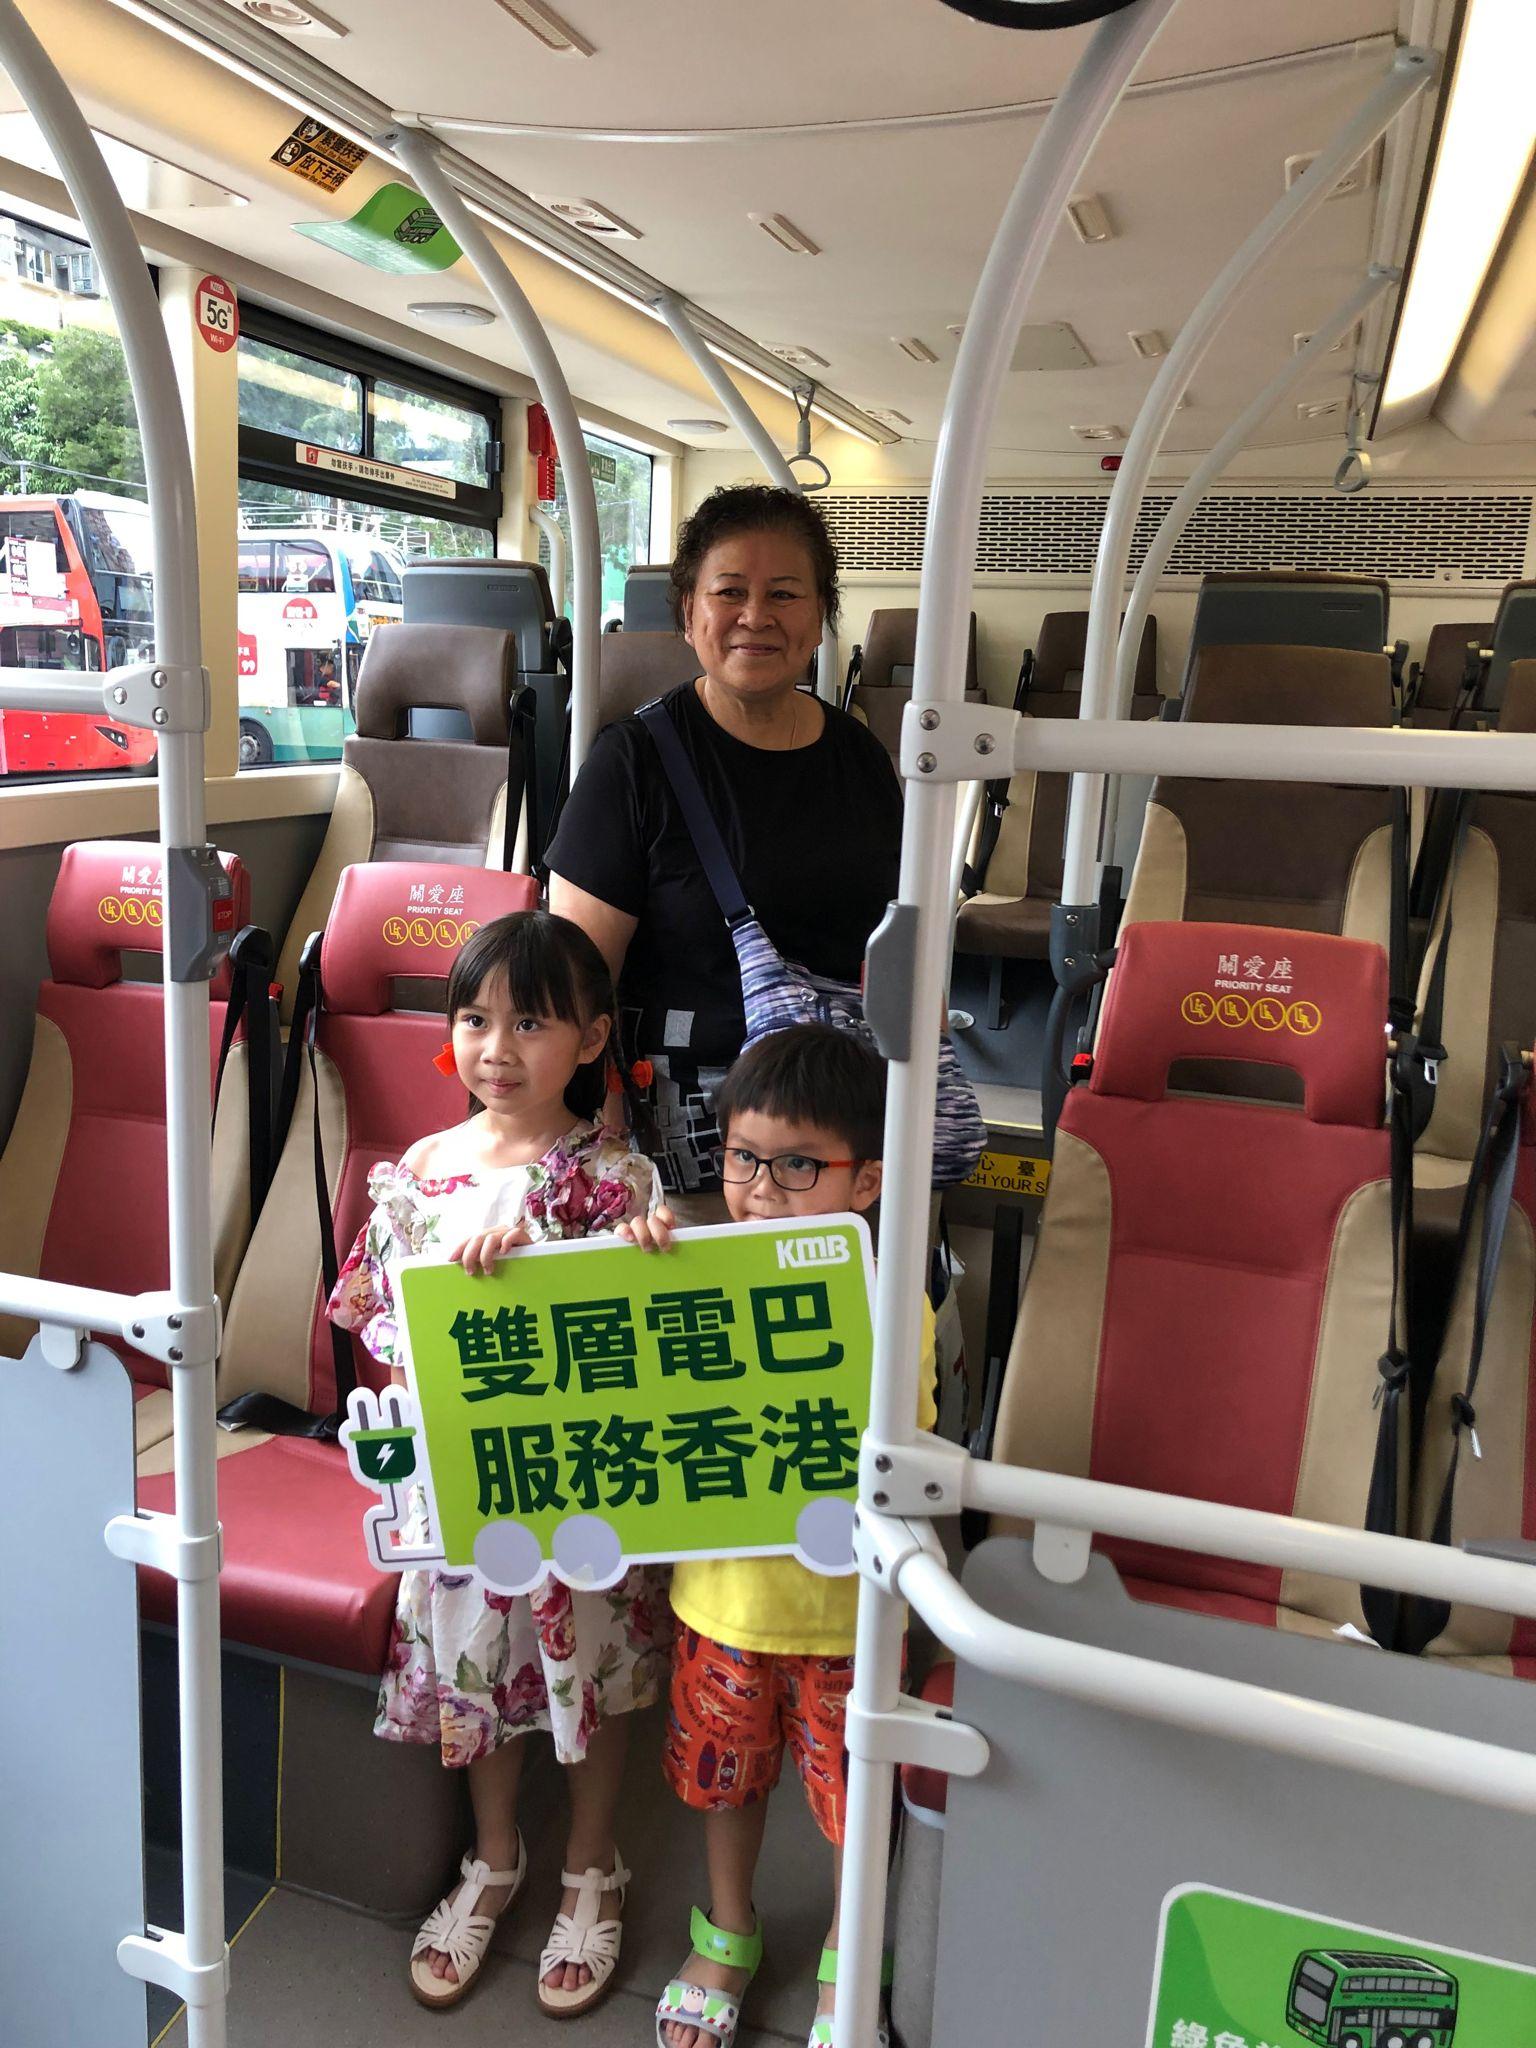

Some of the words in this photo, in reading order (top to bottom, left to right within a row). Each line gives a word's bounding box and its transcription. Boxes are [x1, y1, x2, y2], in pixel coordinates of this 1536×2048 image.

[299, 154, 348, 187] 放下手柄
[207, 298, 228, 330] 5G
[120, 886, 150, 896] PRIORITY
[409, 883, 465, 905] 關愛座
[407, 905, 442, 915] PRIORITY
[443, 907, 464, 916] SEAT
[1217, 954, 1293, 979] 關愛座
[1214, 980, 1262, 992] PRIORITY
[1265, 984, 1292, 993] SEAT
[992, 1175, 1031, 1191] YOUR
[449, 1281, 844, 1403] 雙層電巴
[470, 1397, 859, 1517] 服務香港
